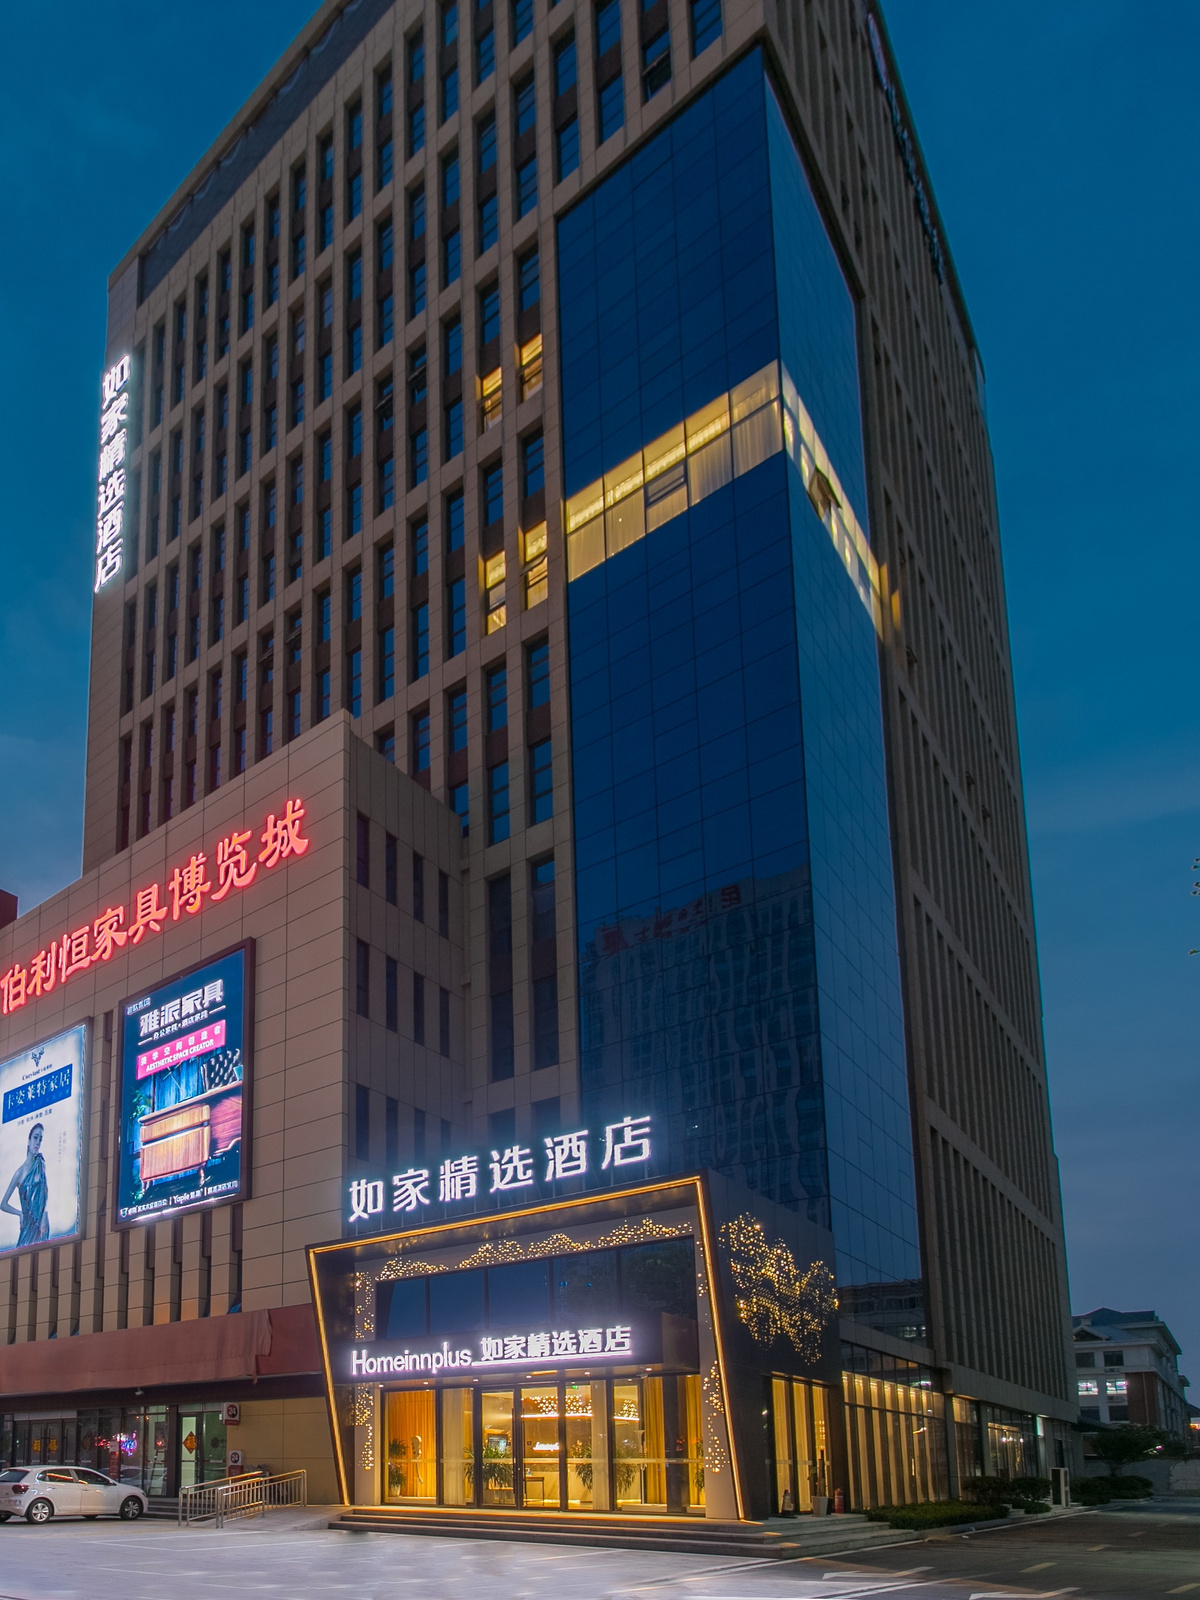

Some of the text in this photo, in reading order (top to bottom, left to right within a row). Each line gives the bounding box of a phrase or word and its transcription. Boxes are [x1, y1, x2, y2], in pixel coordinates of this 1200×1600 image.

[94, 355, 130, 593] 如家精选酒店
[0, 799, 309, 1014] 伯利恒家具博览城
[139, 979, 224, 1037] 雅派家具
[146, 1038, 214, 1072] AESTHETIC SPACE CREATOR
[348, 1115, 652, 1222] 如家精选酒店
[351, 1325, 632, 1375] Homeinnplus 如家精选酒店
[228, 1407, 237, 1416] 24
